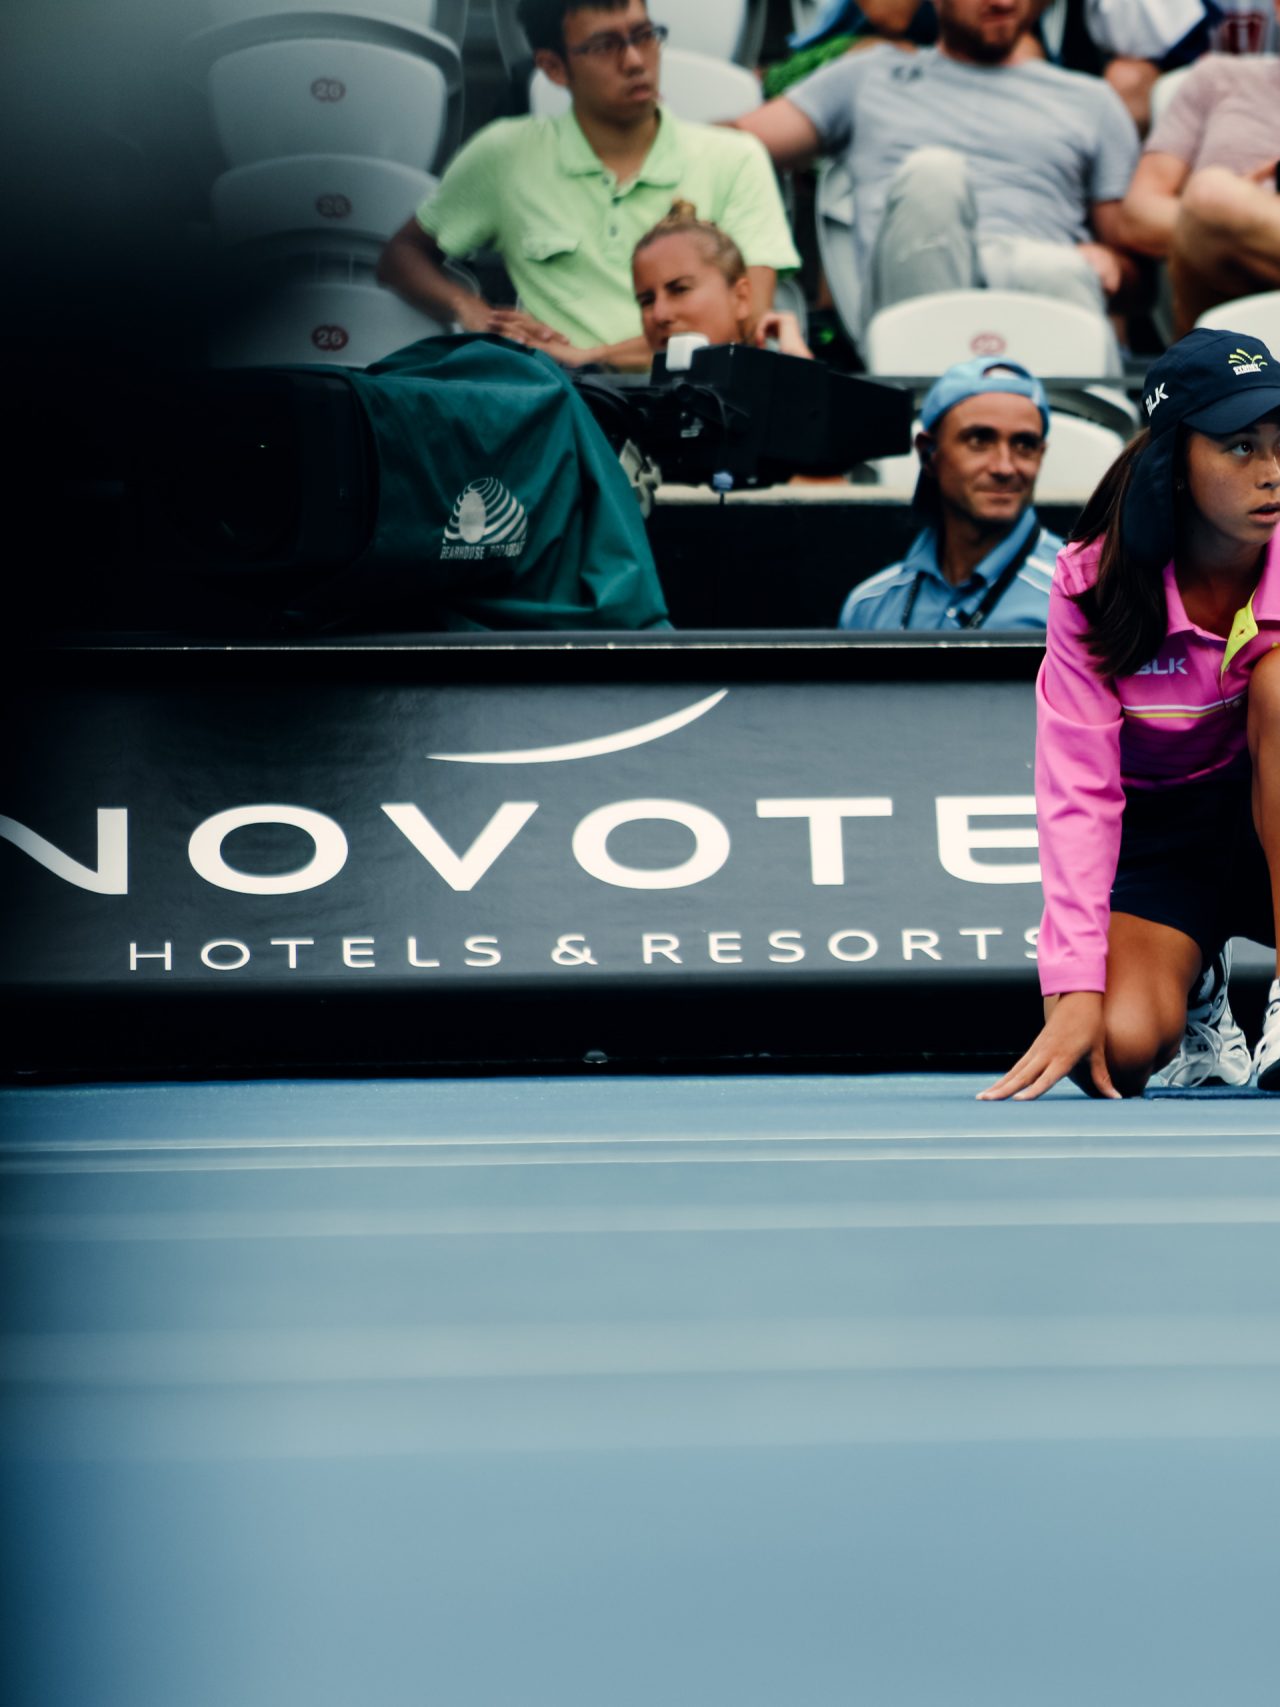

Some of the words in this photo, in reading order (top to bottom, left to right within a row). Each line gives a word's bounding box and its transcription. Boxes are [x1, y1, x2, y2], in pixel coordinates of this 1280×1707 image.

[317, 331, 343, 345] 26
[0, 796, 1042, 895] NOVOTE
[129, 936, 502, 971] HOTELS
[550, 934, 598, 965] &
